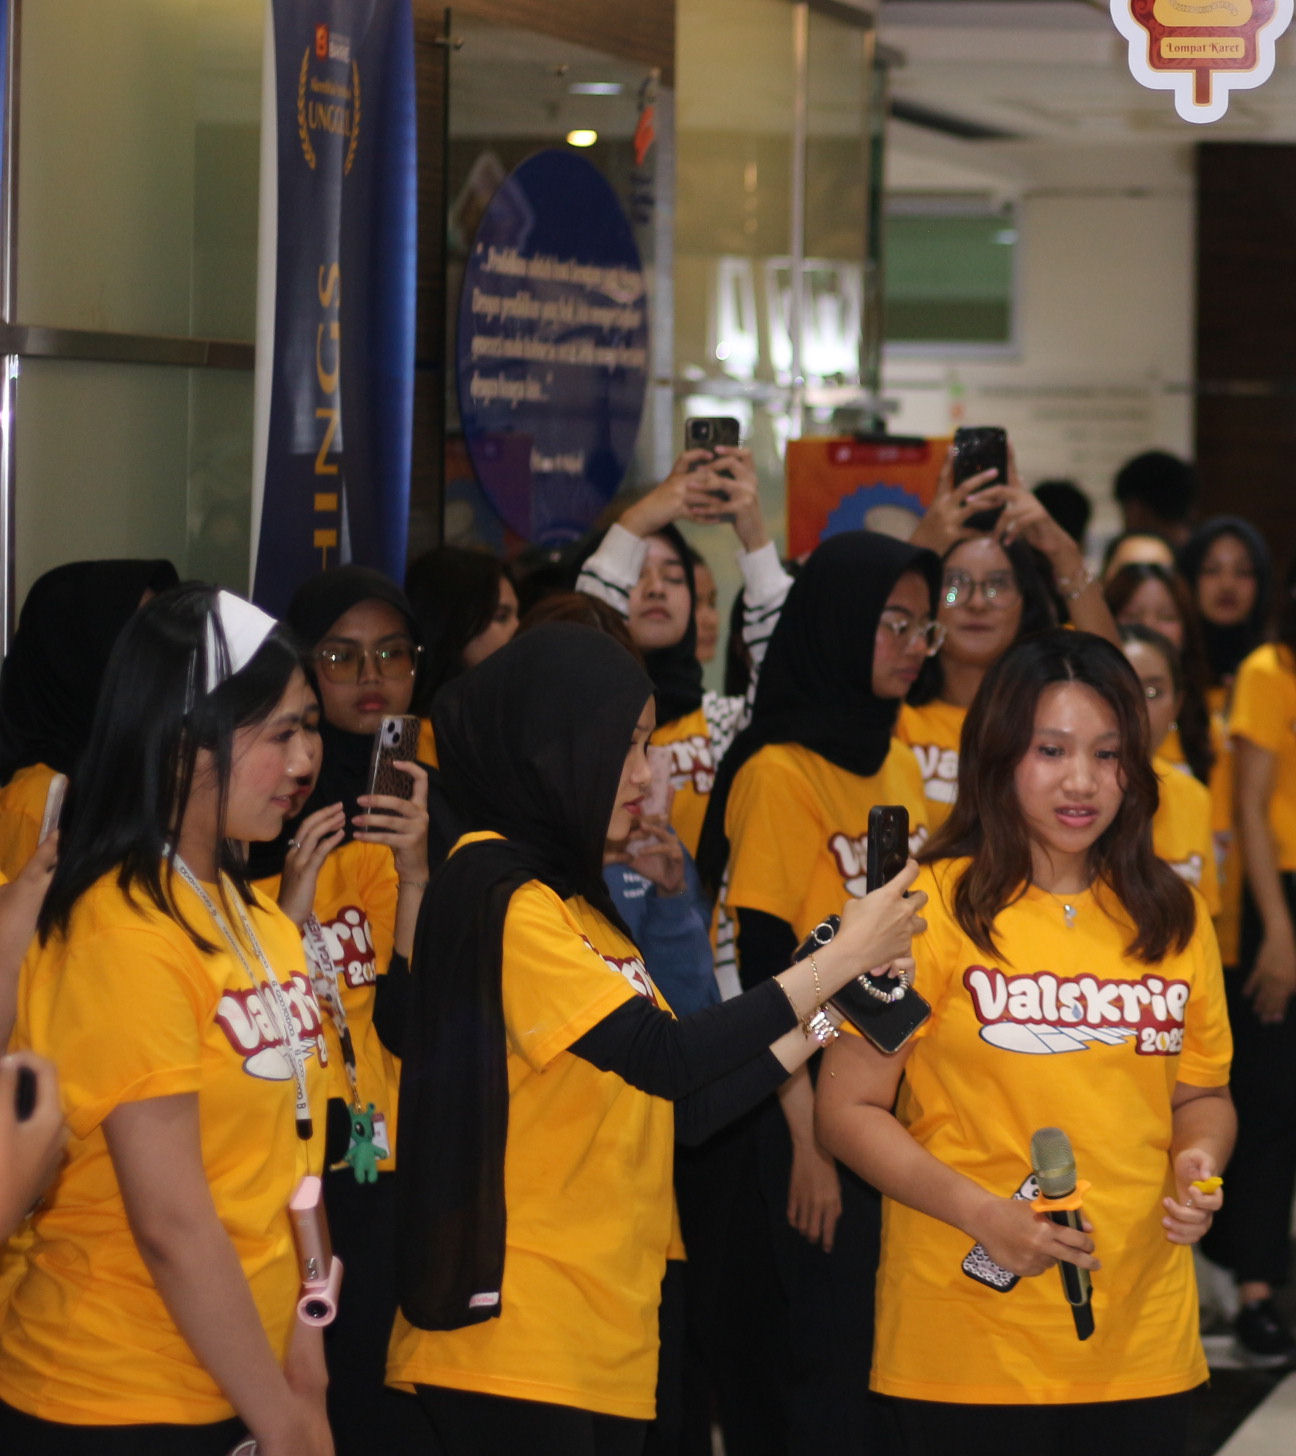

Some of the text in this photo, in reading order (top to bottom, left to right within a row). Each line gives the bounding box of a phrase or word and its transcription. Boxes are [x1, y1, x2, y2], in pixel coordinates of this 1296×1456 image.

[1167, 43, 1240, 54] Lompat Karet
[969, 970, 1189, 1025] Valskrie
